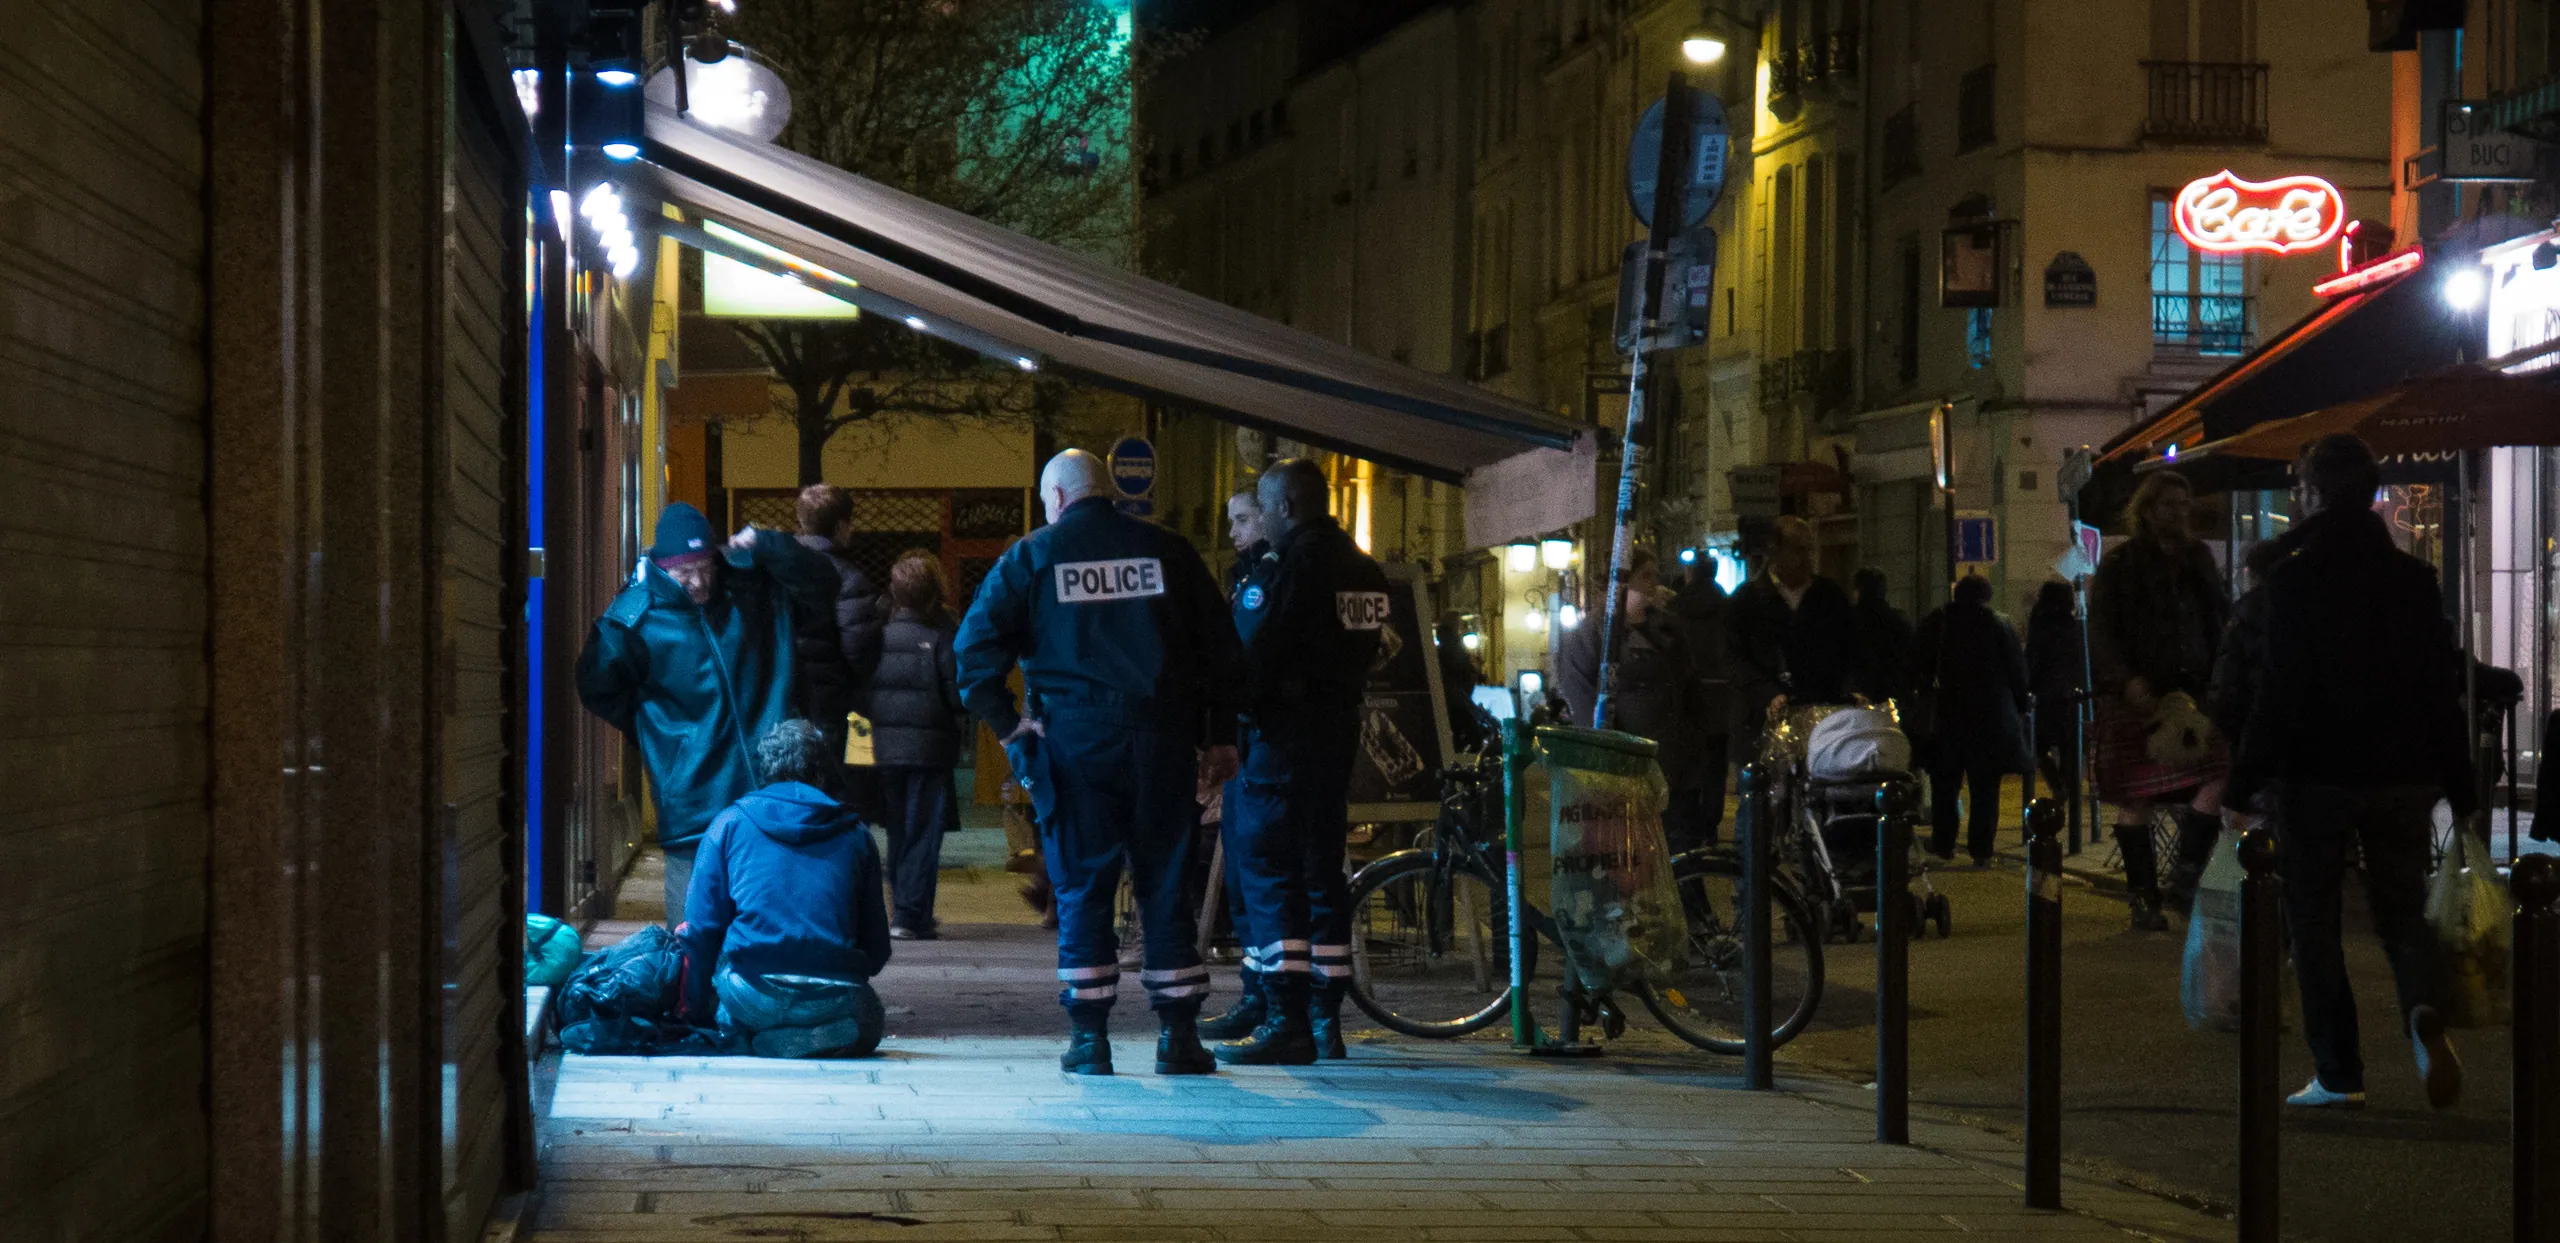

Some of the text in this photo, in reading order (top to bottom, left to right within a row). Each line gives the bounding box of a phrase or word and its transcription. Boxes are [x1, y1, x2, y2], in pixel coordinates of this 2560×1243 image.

[2470, 143, 2511, 166] BUCI
[2380, 412, 2468, 427] MARTINI
[1062, 562, 1157, 596] POLICE
